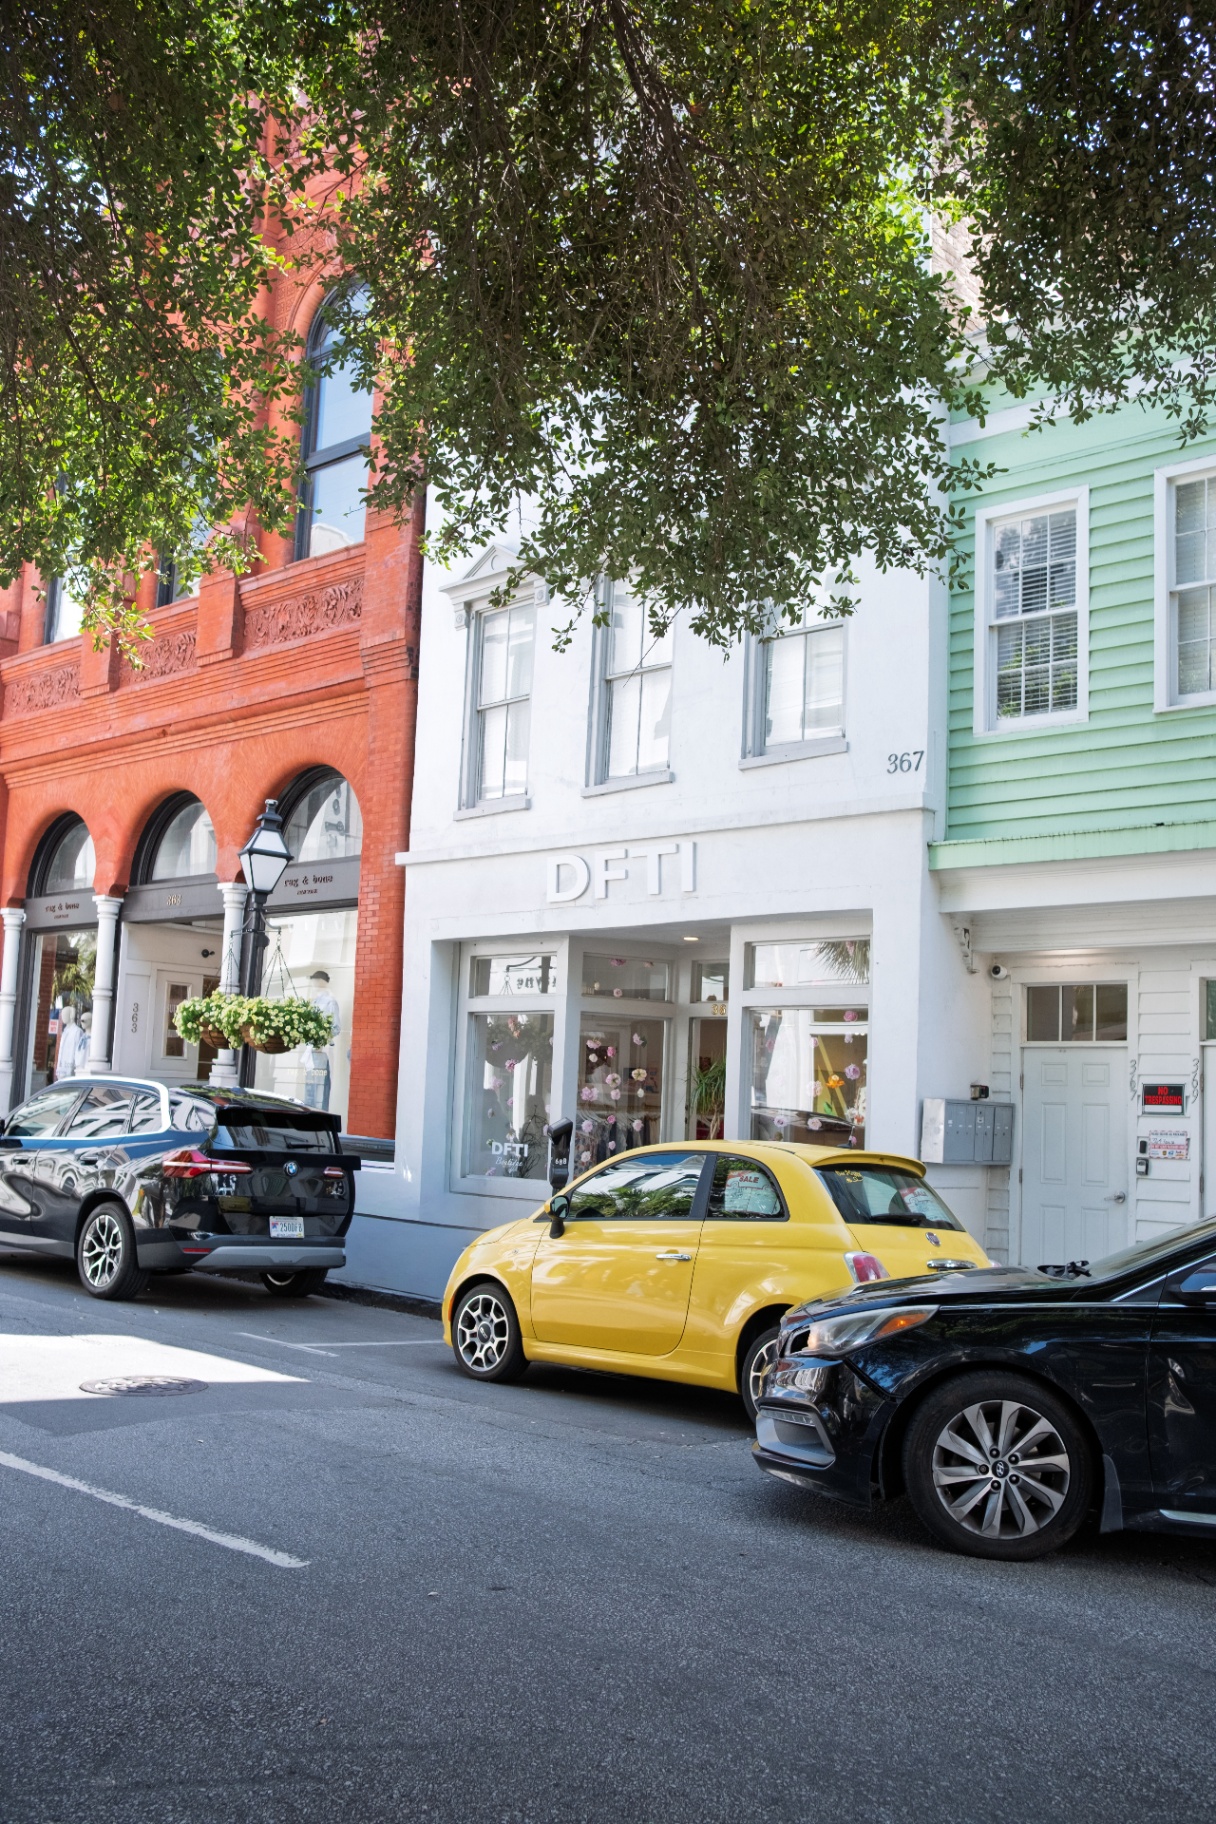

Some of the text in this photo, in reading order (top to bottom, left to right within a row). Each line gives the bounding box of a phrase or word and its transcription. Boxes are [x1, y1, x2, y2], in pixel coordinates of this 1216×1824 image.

[887, 750, 924, 774] 367
[284, 875, 333, 887] rag & bone
[546, 841, 696, 904] DFTI
[131, 1002, 139, 1034] 363
[1129, 1059, 1138, 1101] 367
[1158, 1086, 1169, 1096] NO
[1191, 1058, 1200, 1104] 369
[1145, 1096, 1182, 1105] TRESPASSING
[491, 1142, 528, 1158] DFTI
